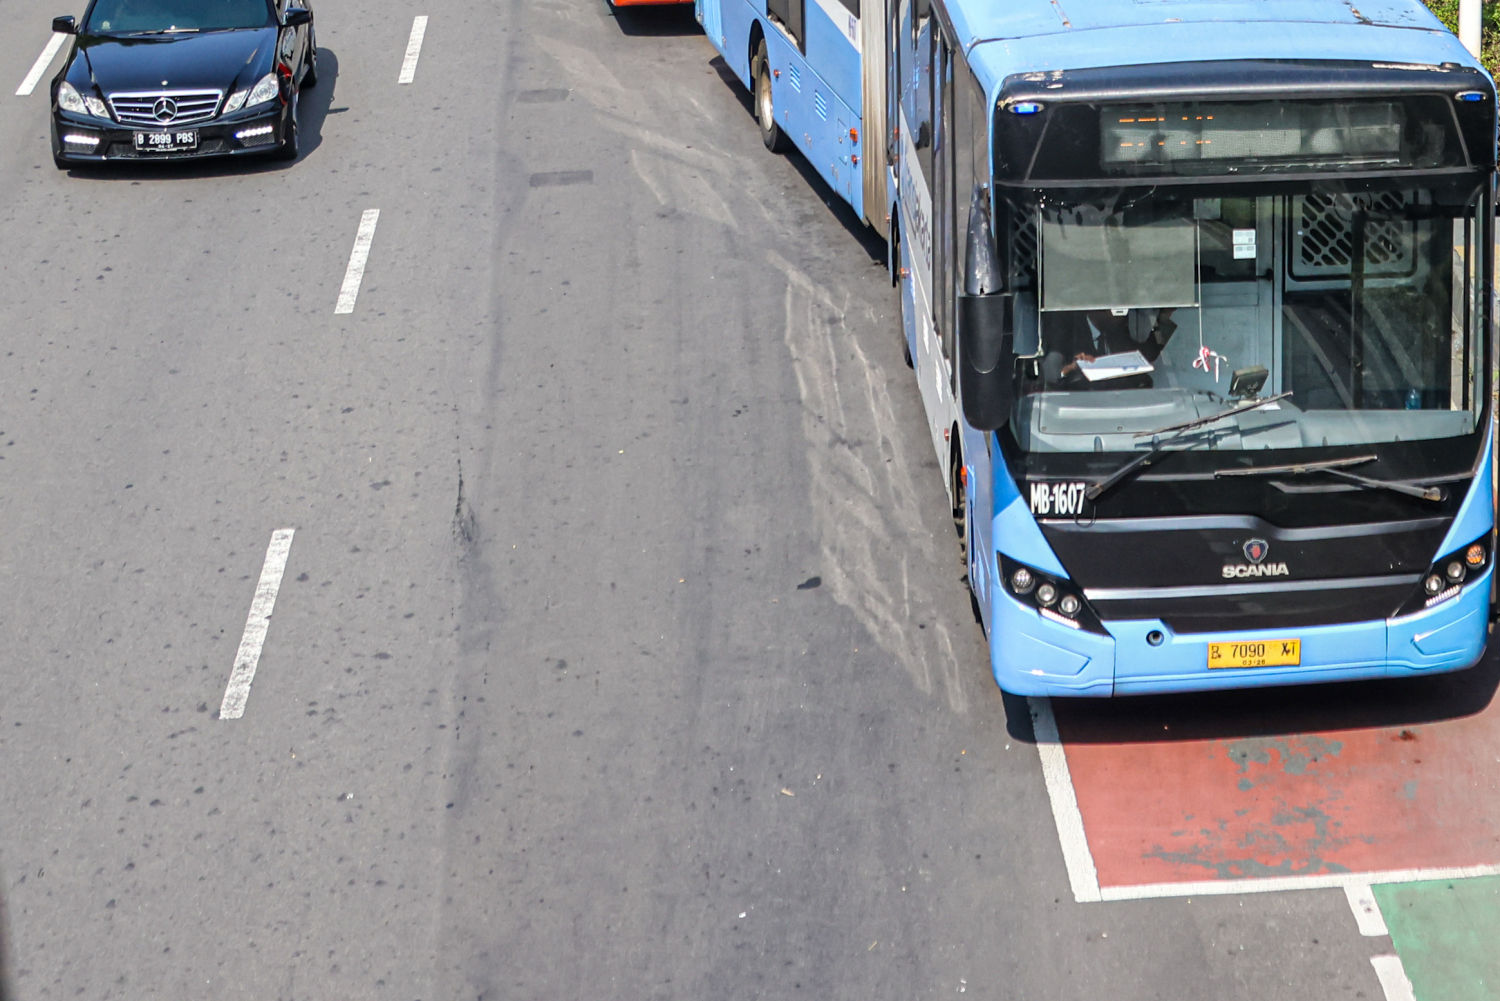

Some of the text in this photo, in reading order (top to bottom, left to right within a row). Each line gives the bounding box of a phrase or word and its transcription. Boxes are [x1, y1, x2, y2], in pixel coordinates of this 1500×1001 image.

[138, 132, 193, 144] B 2899 PBS
[1030, 482, 1086, 515] MB-1607
[1222, 562, 1290, 579] SCANIA
[1230, 643, 1265, 659] 7090
